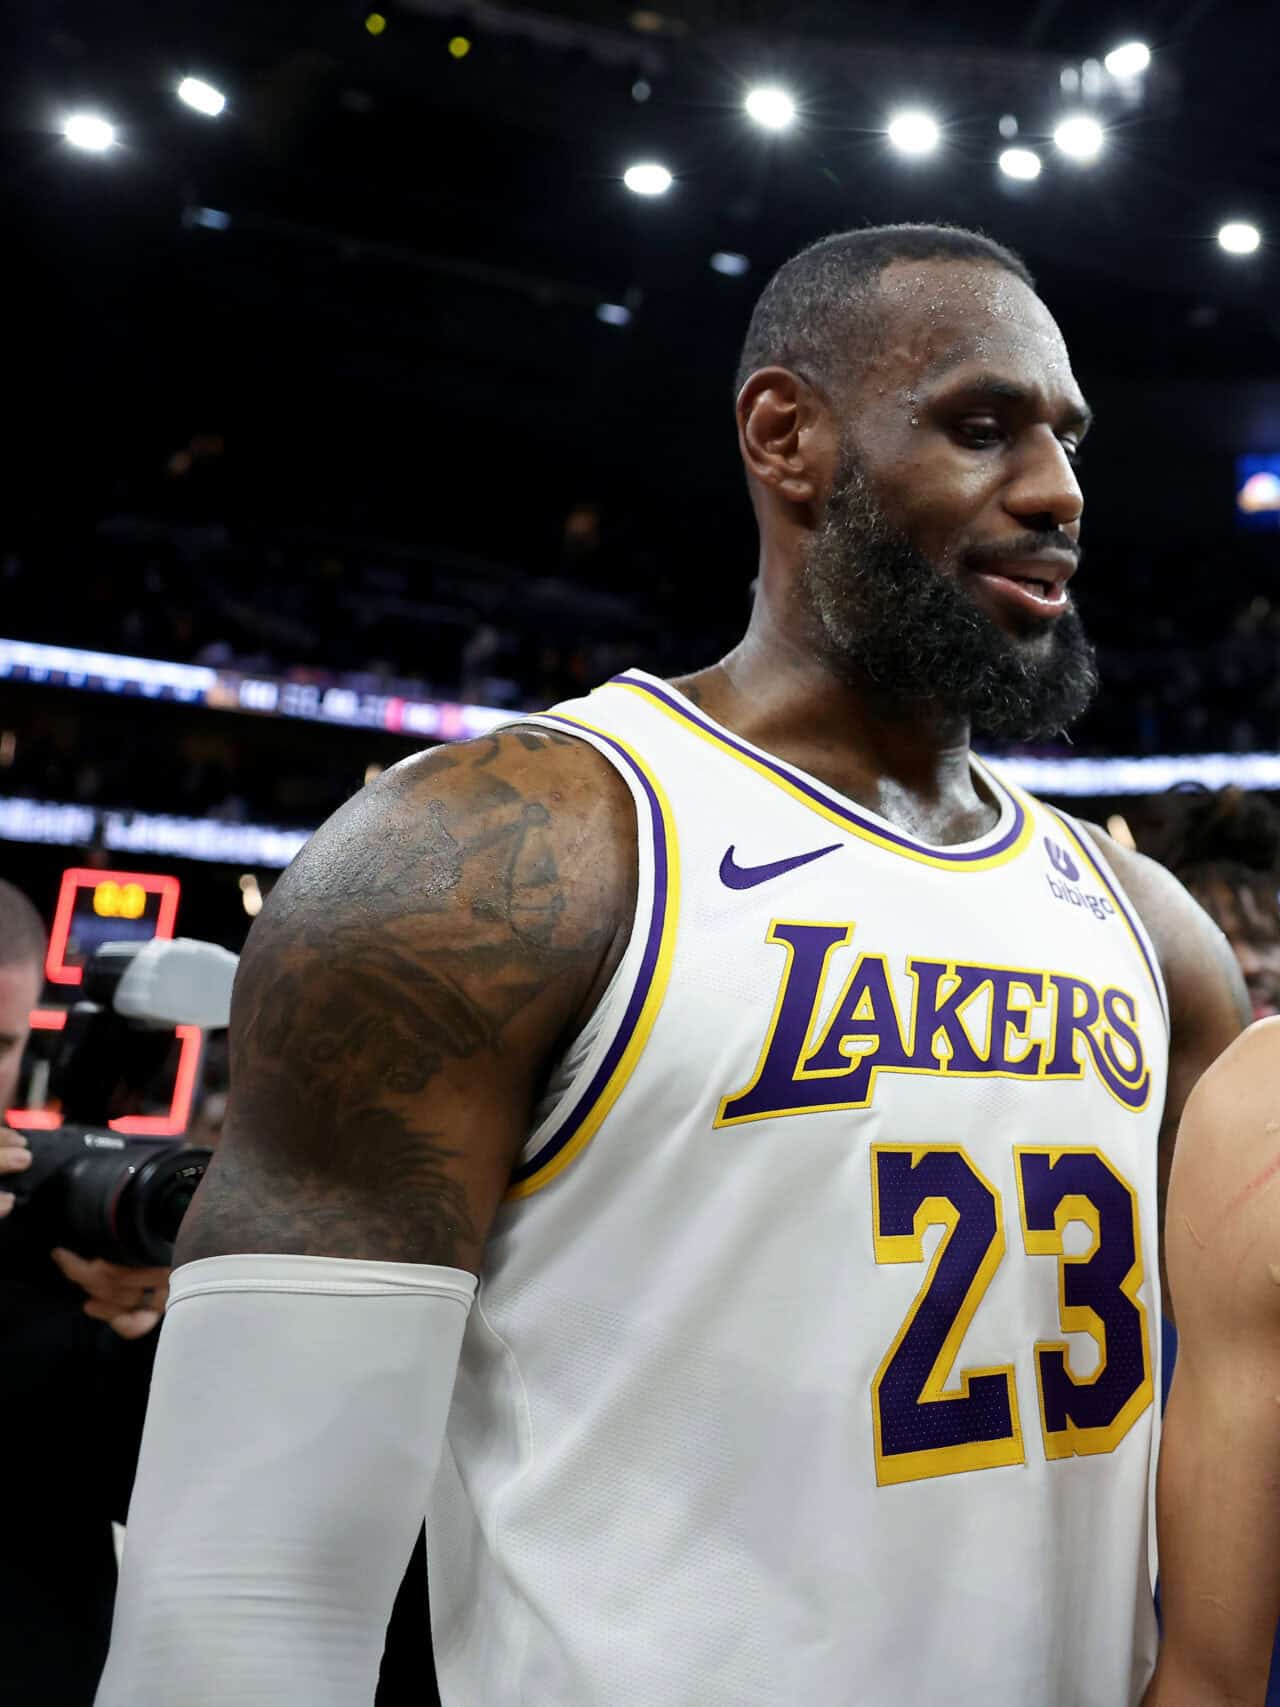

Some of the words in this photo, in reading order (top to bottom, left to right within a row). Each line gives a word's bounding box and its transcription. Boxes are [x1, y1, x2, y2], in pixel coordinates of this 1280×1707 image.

[1046, 873, 1115, 920] bibigo
[712, 918, 1152, 1130] LAKERS
[870, 1142, 1154, 1487] 23
